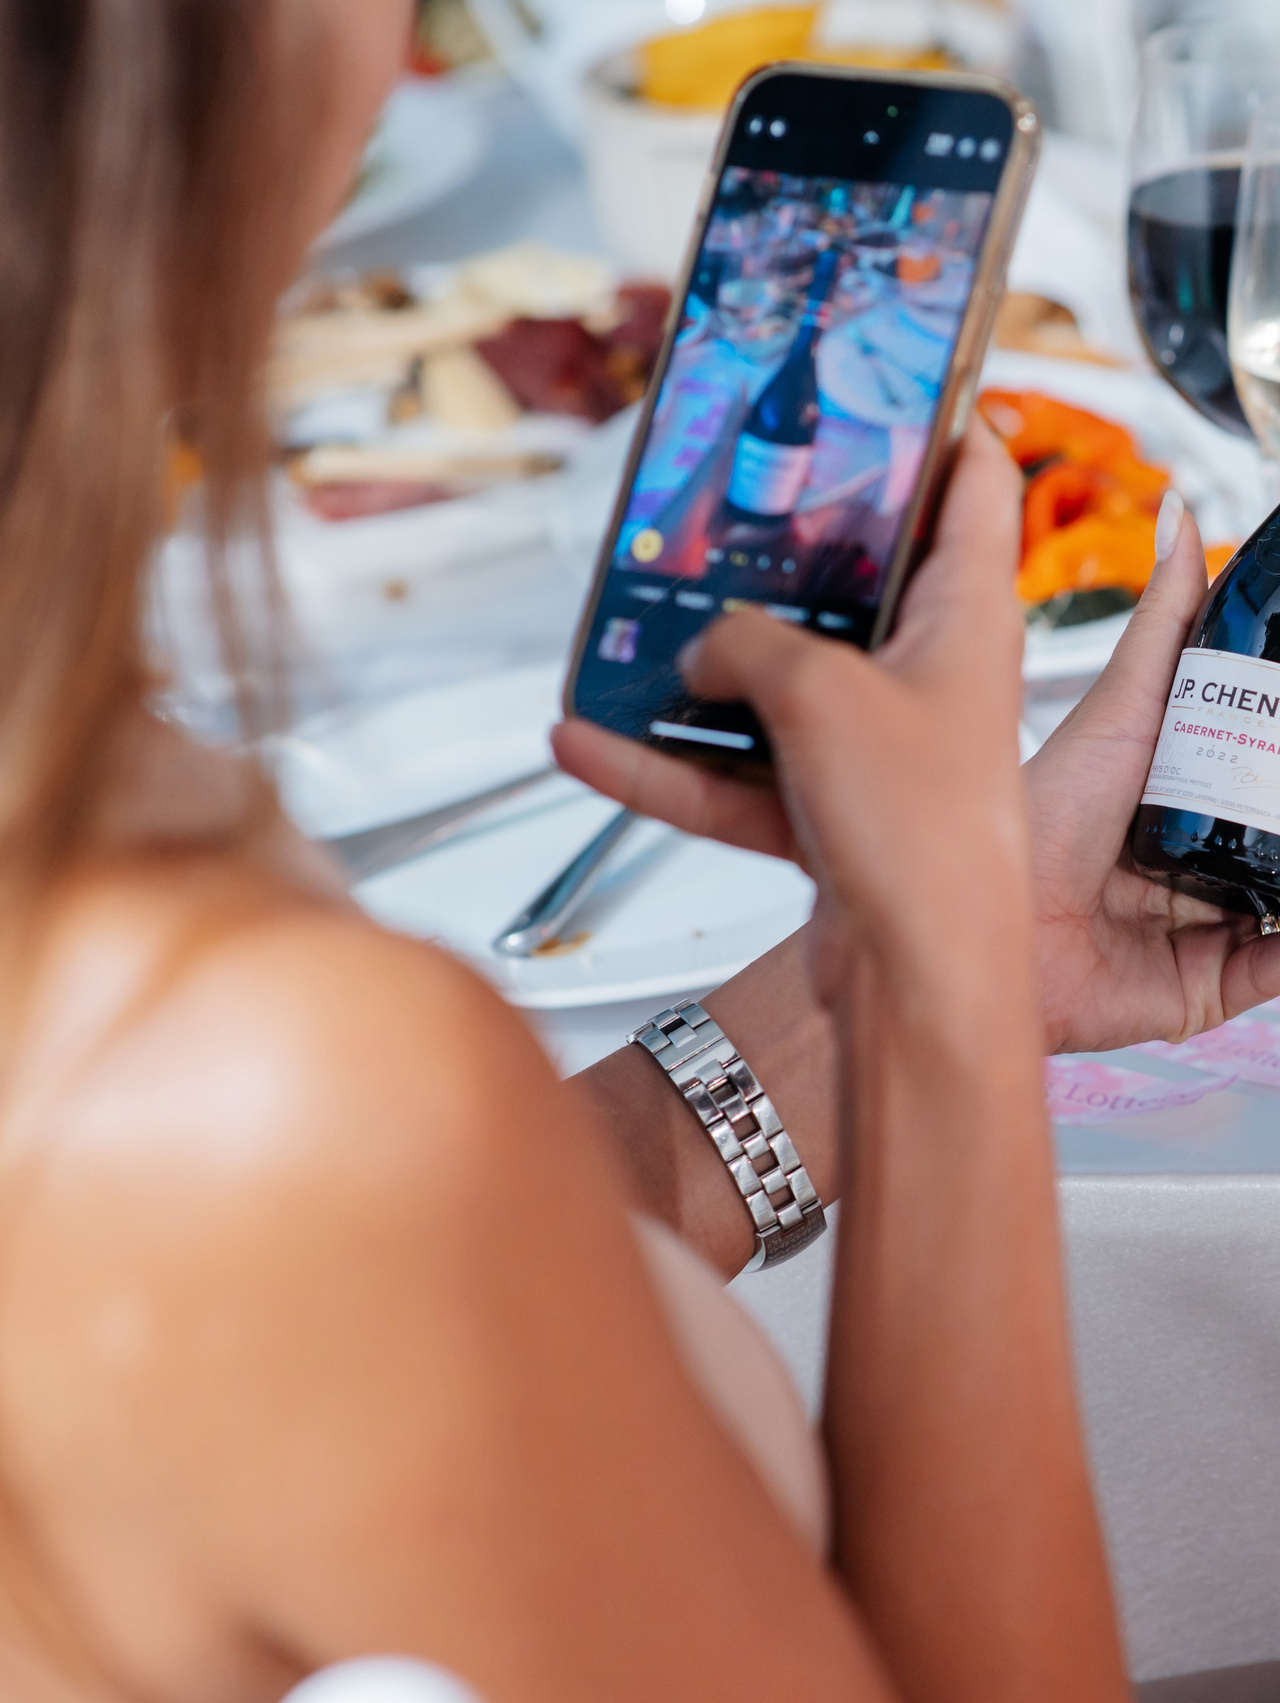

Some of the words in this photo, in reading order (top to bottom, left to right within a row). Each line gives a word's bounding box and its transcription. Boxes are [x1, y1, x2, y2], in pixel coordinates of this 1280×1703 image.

[1174, 679, 1196, 699] JP.
[1197, 706, 1265, 728] FRANCE
[1196, 745, 1239, 764] 2022
